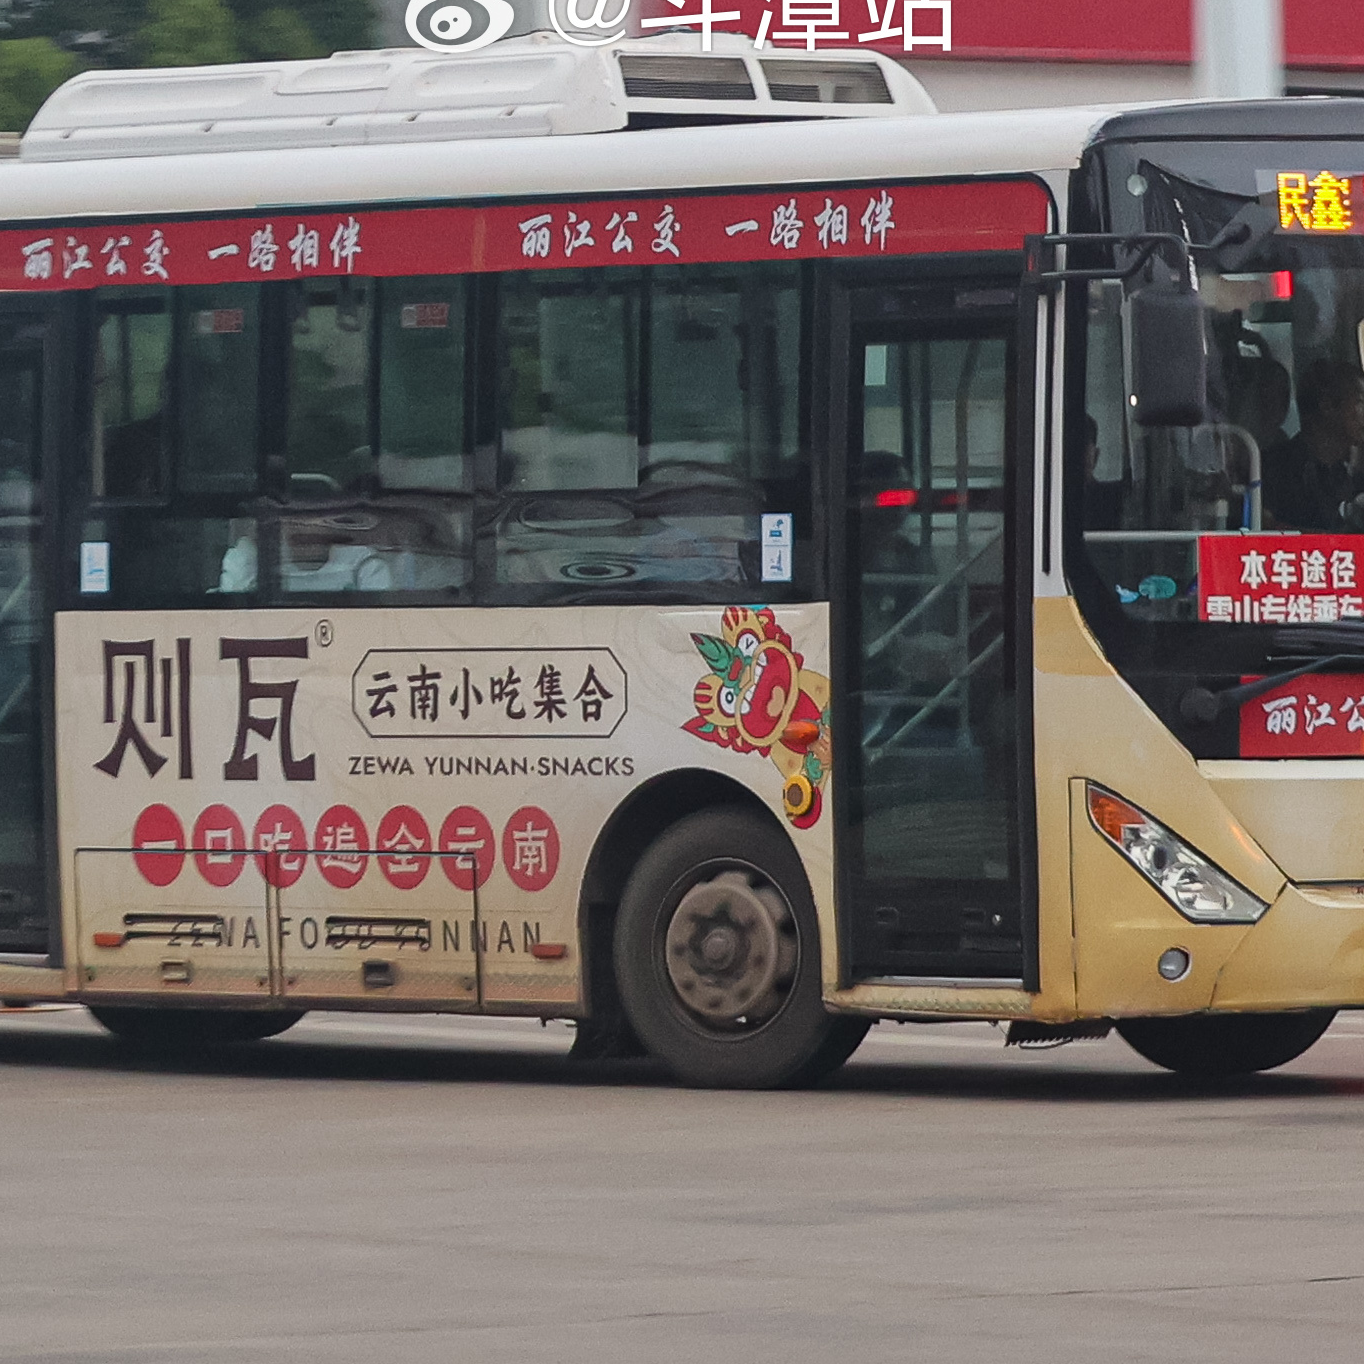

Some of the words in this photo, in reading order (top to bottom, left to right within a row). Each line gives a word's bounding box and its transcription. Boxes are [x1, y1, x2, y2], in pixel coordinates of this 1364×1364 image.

[517, 203, 682, 258] 丽江公交
[724, 189, 897, 252] 一路相伴
[1277, 170, 1354, 231] 民鑫
[21, 228, 170, 281] 丽江公交
[207, 215, 363, 275] 一路相伴
[1240, 550, 1358, 590] 本车途径
[93, 636, 317, 782] 则瓦
[365, 663, 615, 724] 云南小吃集合
[347, 755, 415, 776] ZEWA
[141, 819, 550, 877] 一口吃遍全云南
